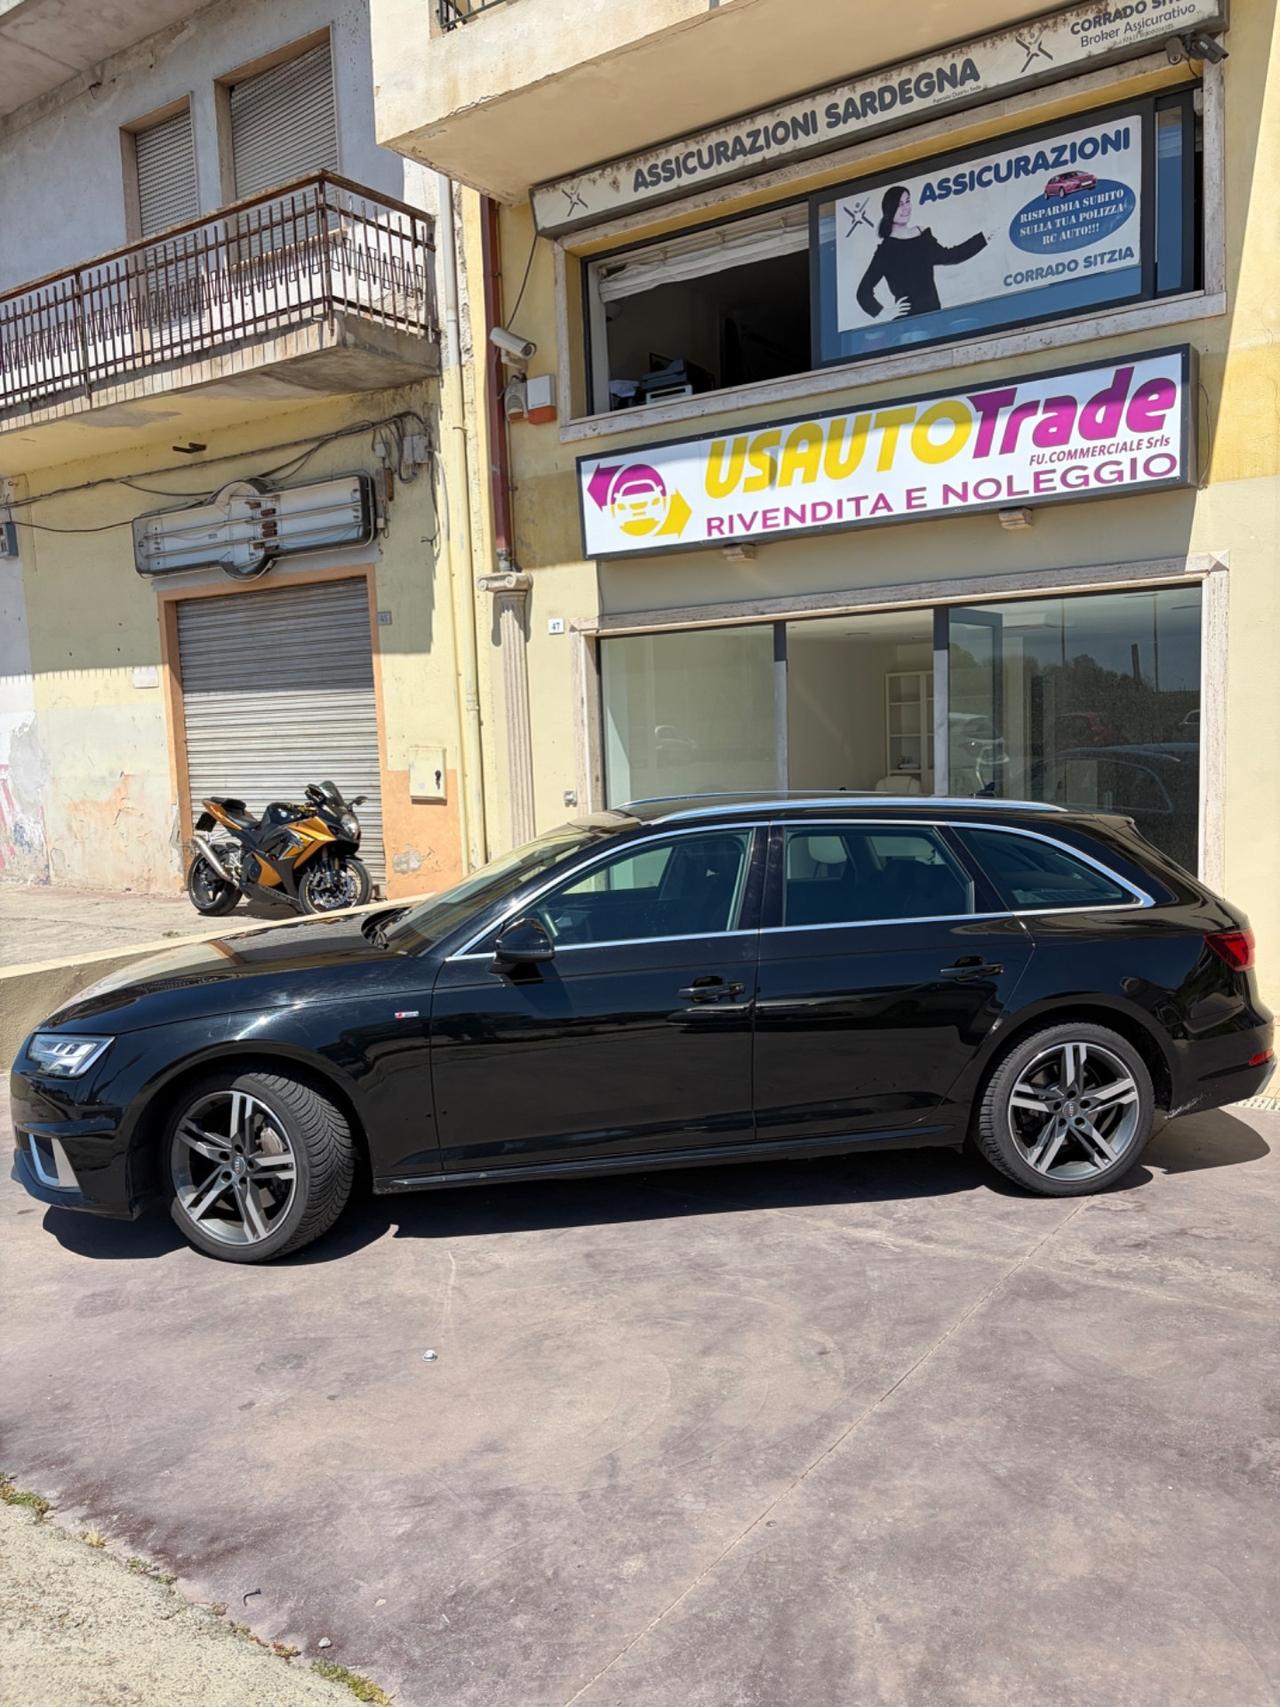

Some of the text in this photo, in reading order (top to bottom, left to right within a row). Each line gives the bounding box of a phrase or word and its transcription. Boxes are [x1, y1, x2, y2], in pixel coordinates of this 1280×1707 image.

[1070, 0, 1148, 35] CORRADO
[1080, 27, 1121, 48] Broker
[1123, 3, 1197, 35] Assicurativo
[633, 58, 981, 192] ASSICURAZIONI SARDEGNA
[919, 128, 1130, 205] ASSICURAZIONI
[1020, 188, 1125, 224] RISPARMIA SUBITO
[1020, 202, 1124, 237] SULLA TUA POLIZZA
[1042, 222, 1101, 246] RC AUTO!!!
[1003, 246, 1135, 287] CORRADO SITZIA
[705, 451, 1178, 538] RIVENDITA E NOLEGGIO
